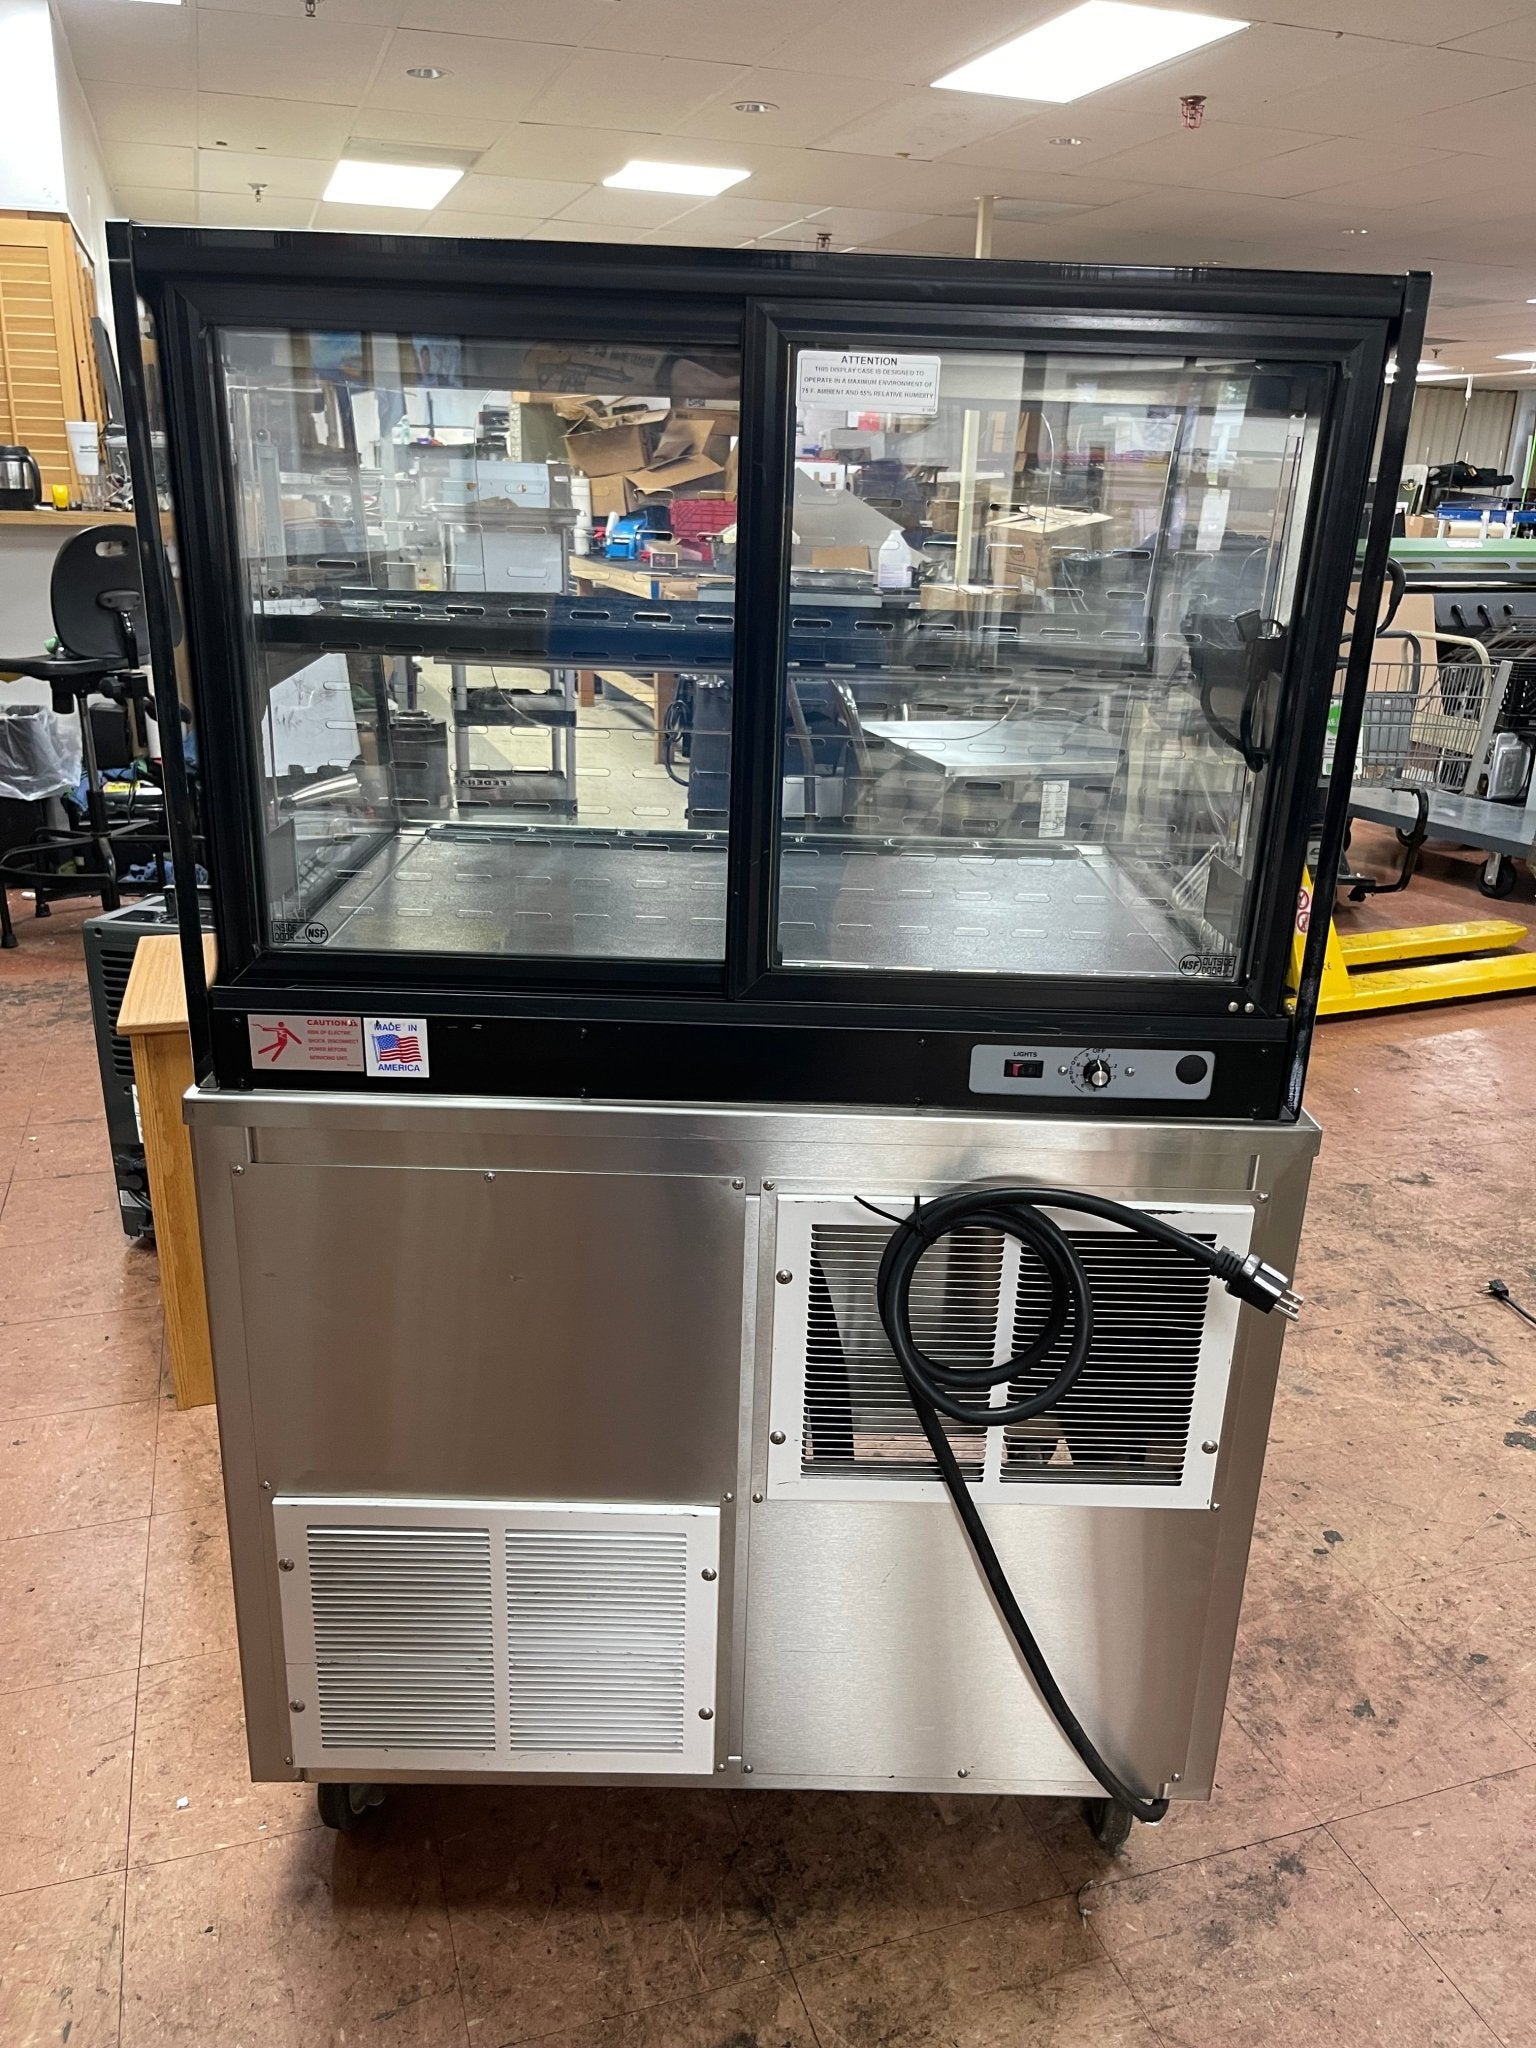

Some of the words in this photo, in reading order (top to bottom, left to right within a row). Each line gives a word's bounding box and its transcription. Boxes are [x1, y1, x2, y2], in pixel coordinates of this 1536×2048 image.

[841, 355, 898, 366] ATTENTION
[830, 366, 857, 374] DISPLAY
[873, 390, 902, 398] RELATIVE
[308, 928, 326, 938] NSF
[1181, 960, 1200, 970] NSF
[374, 1023, 401, 1032] MADE
[408, 1024, 417, 1032] IN
[377, 1063, 421, 1072] AMERICA
